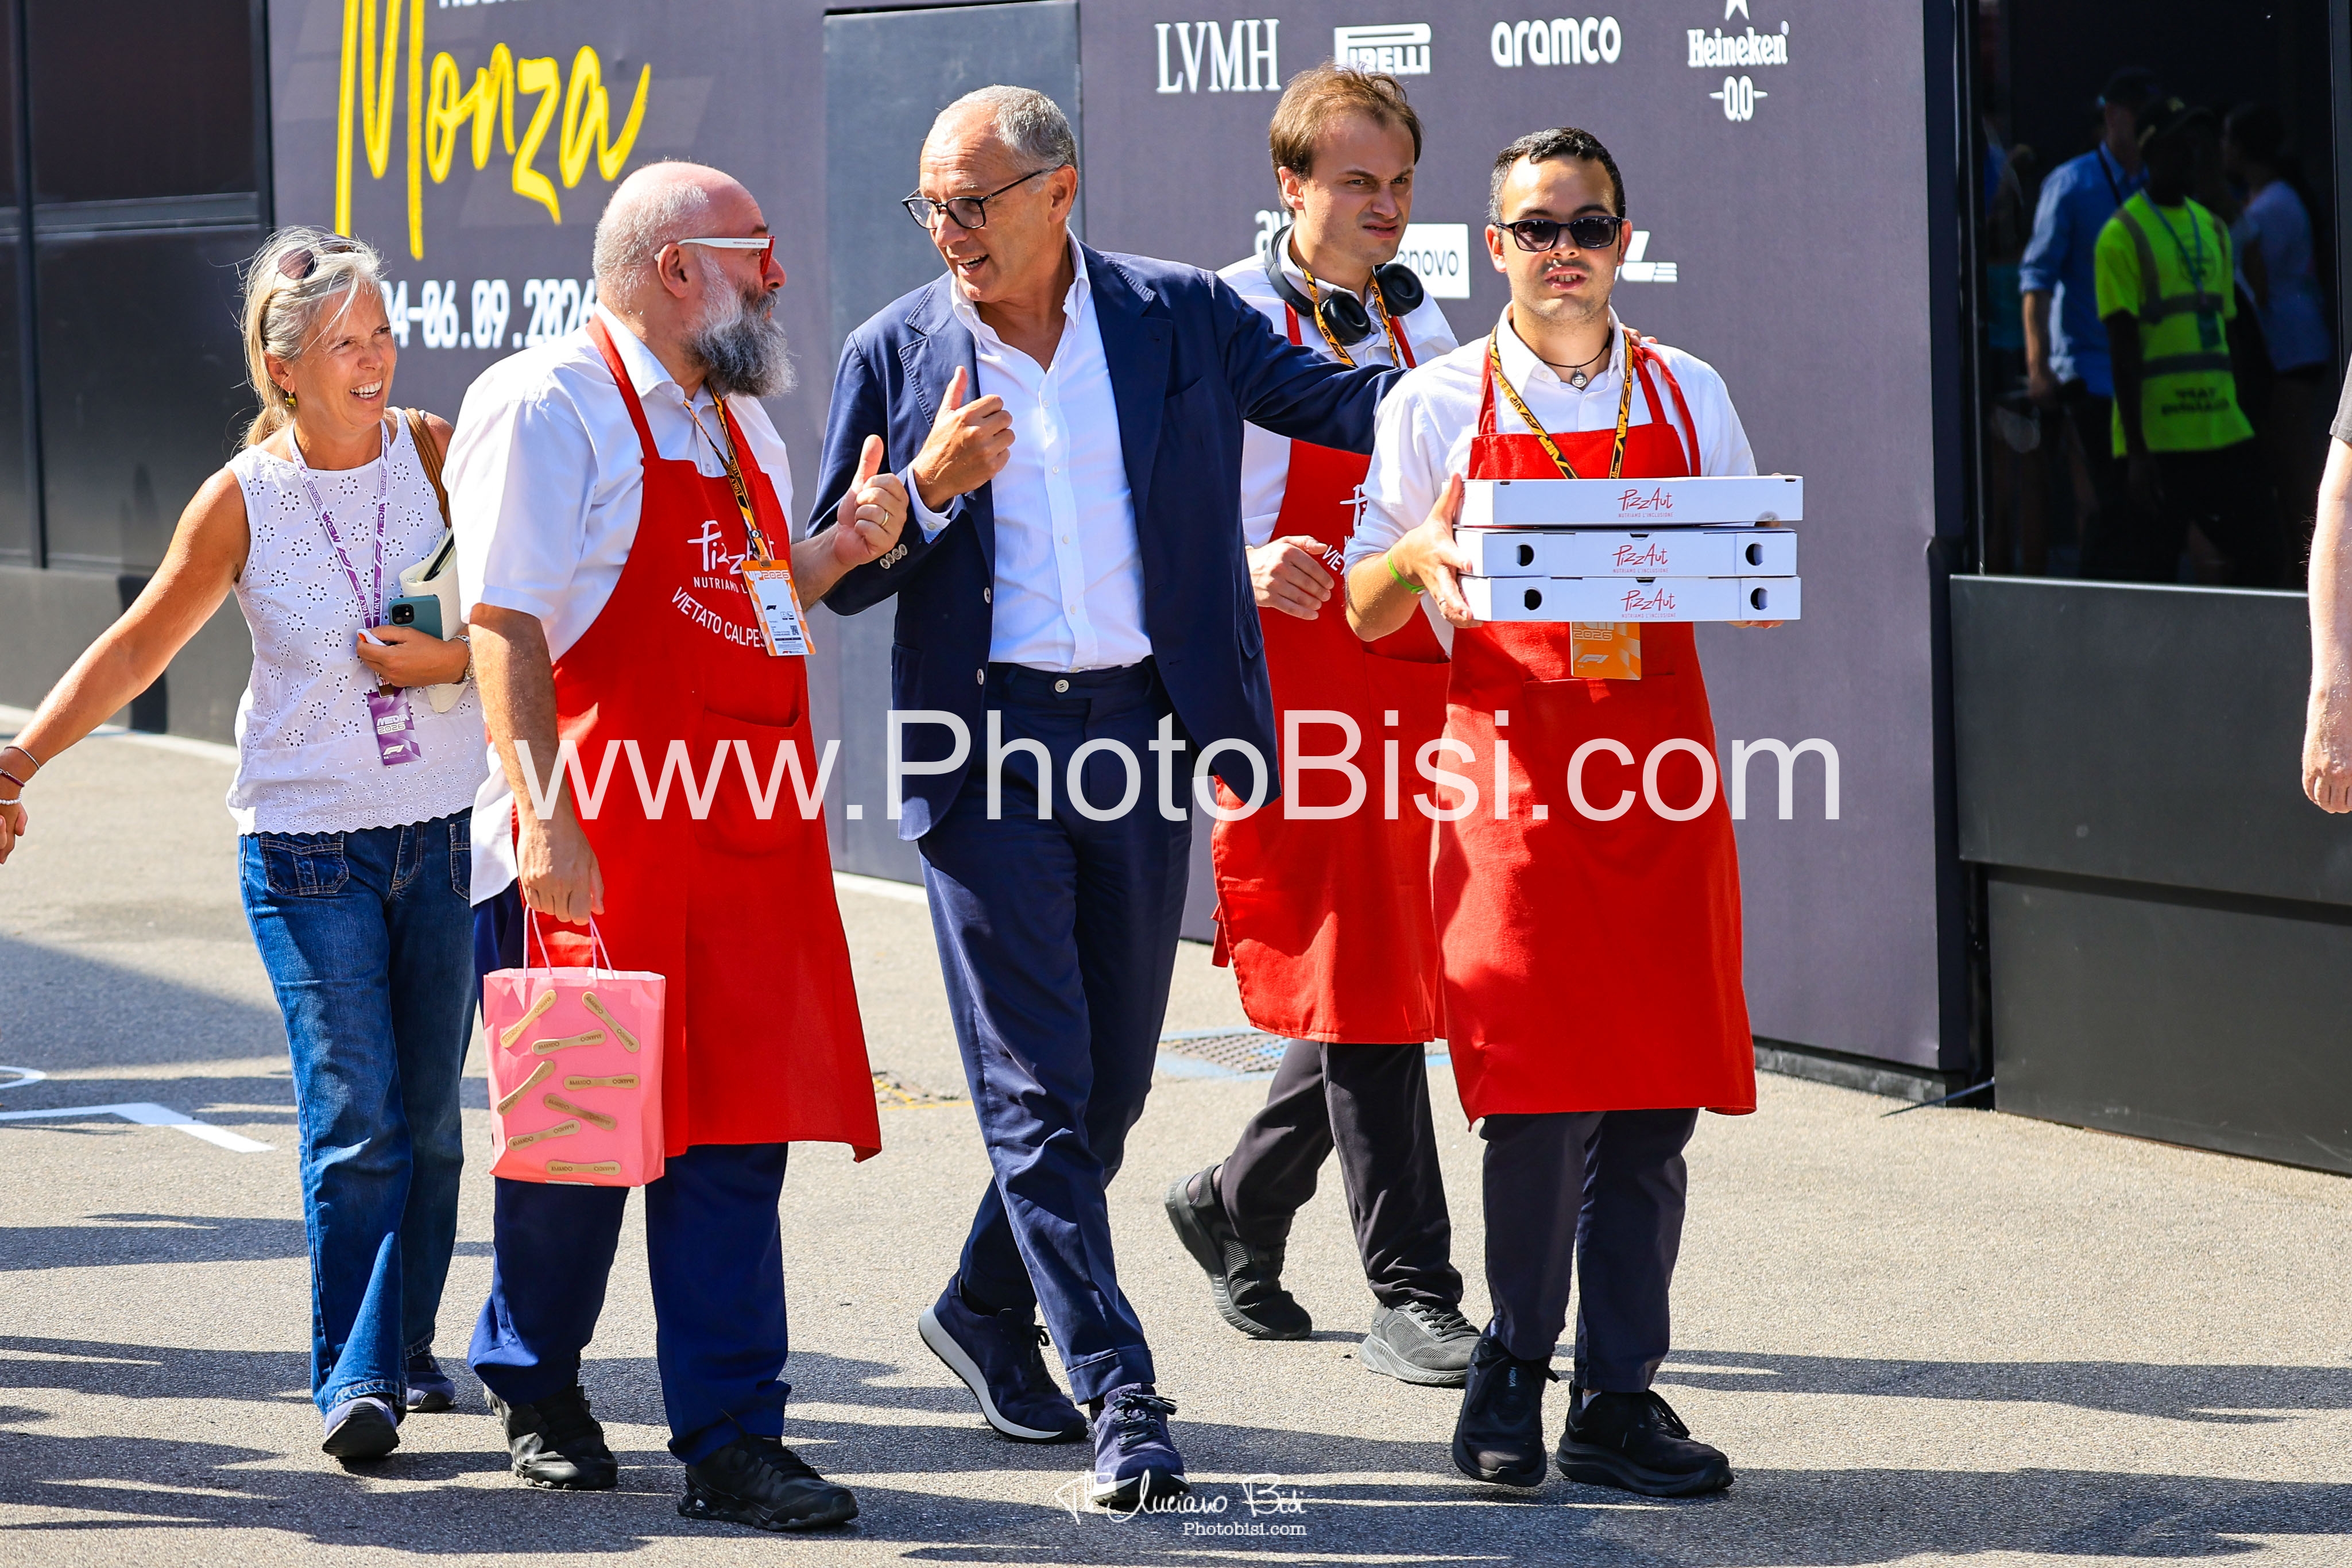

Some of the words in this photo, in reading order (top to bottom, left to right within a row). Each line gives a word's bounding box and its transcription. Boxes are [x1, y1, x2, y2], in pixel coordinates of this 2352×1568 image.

[1334, 22, 1432, 75] PIRELLI
[1491, 16, 1622, 67] aramco
[1687, 26, 1789, 68] Heineken
[1154, 18, 1282, 94] LVMH
[335, 0, 651, 261] Monza
[1396, 249, 1459, 277] enovo
[1617, 487, 1673, 511] PizzAut
[322, 510, 341, 543] MEDIA
[377, 503, 385, 537] MEDIA
[1612, 543, 1668, 567] PizzAut
[763, 570, 791, 580] 2026
[359, 599, 370, 619] ITALY
[671, 586, 722, 634] VIETATO
[1620, 587, 1676, 611] PizzAut
[1573, 628, 1612, 641] 2026
[377, 714, 410, 726] MEDIA
[377, 722, 406, 734] 2026
